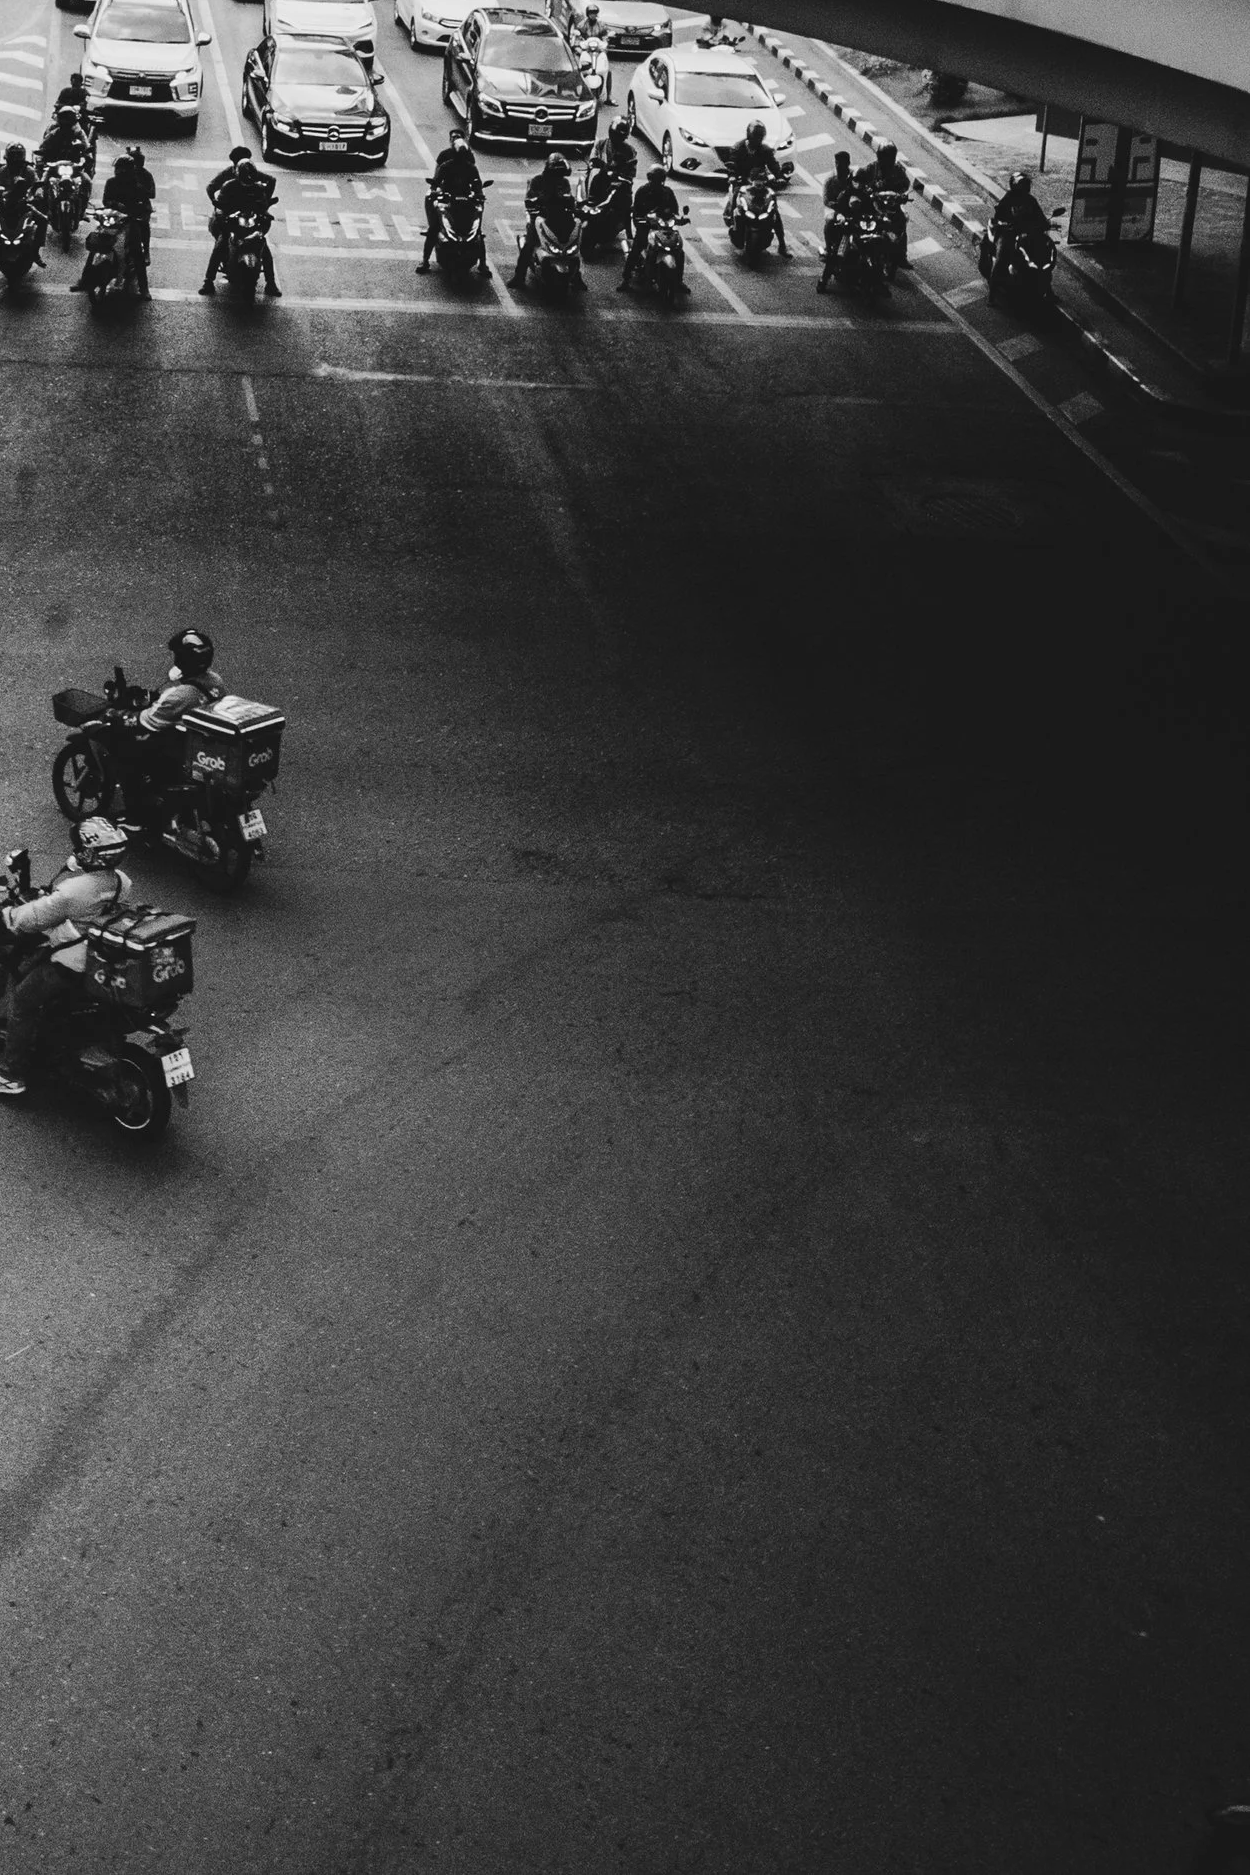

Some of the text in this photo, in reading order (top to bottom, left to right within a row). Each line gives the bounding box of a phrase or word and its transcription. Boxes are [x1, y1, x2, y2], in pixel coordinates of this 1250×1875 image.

[195, 751, 226, 772] Grab
[248, 747, 274, 768] Grab
[152, 957, 186, 983] Grab
